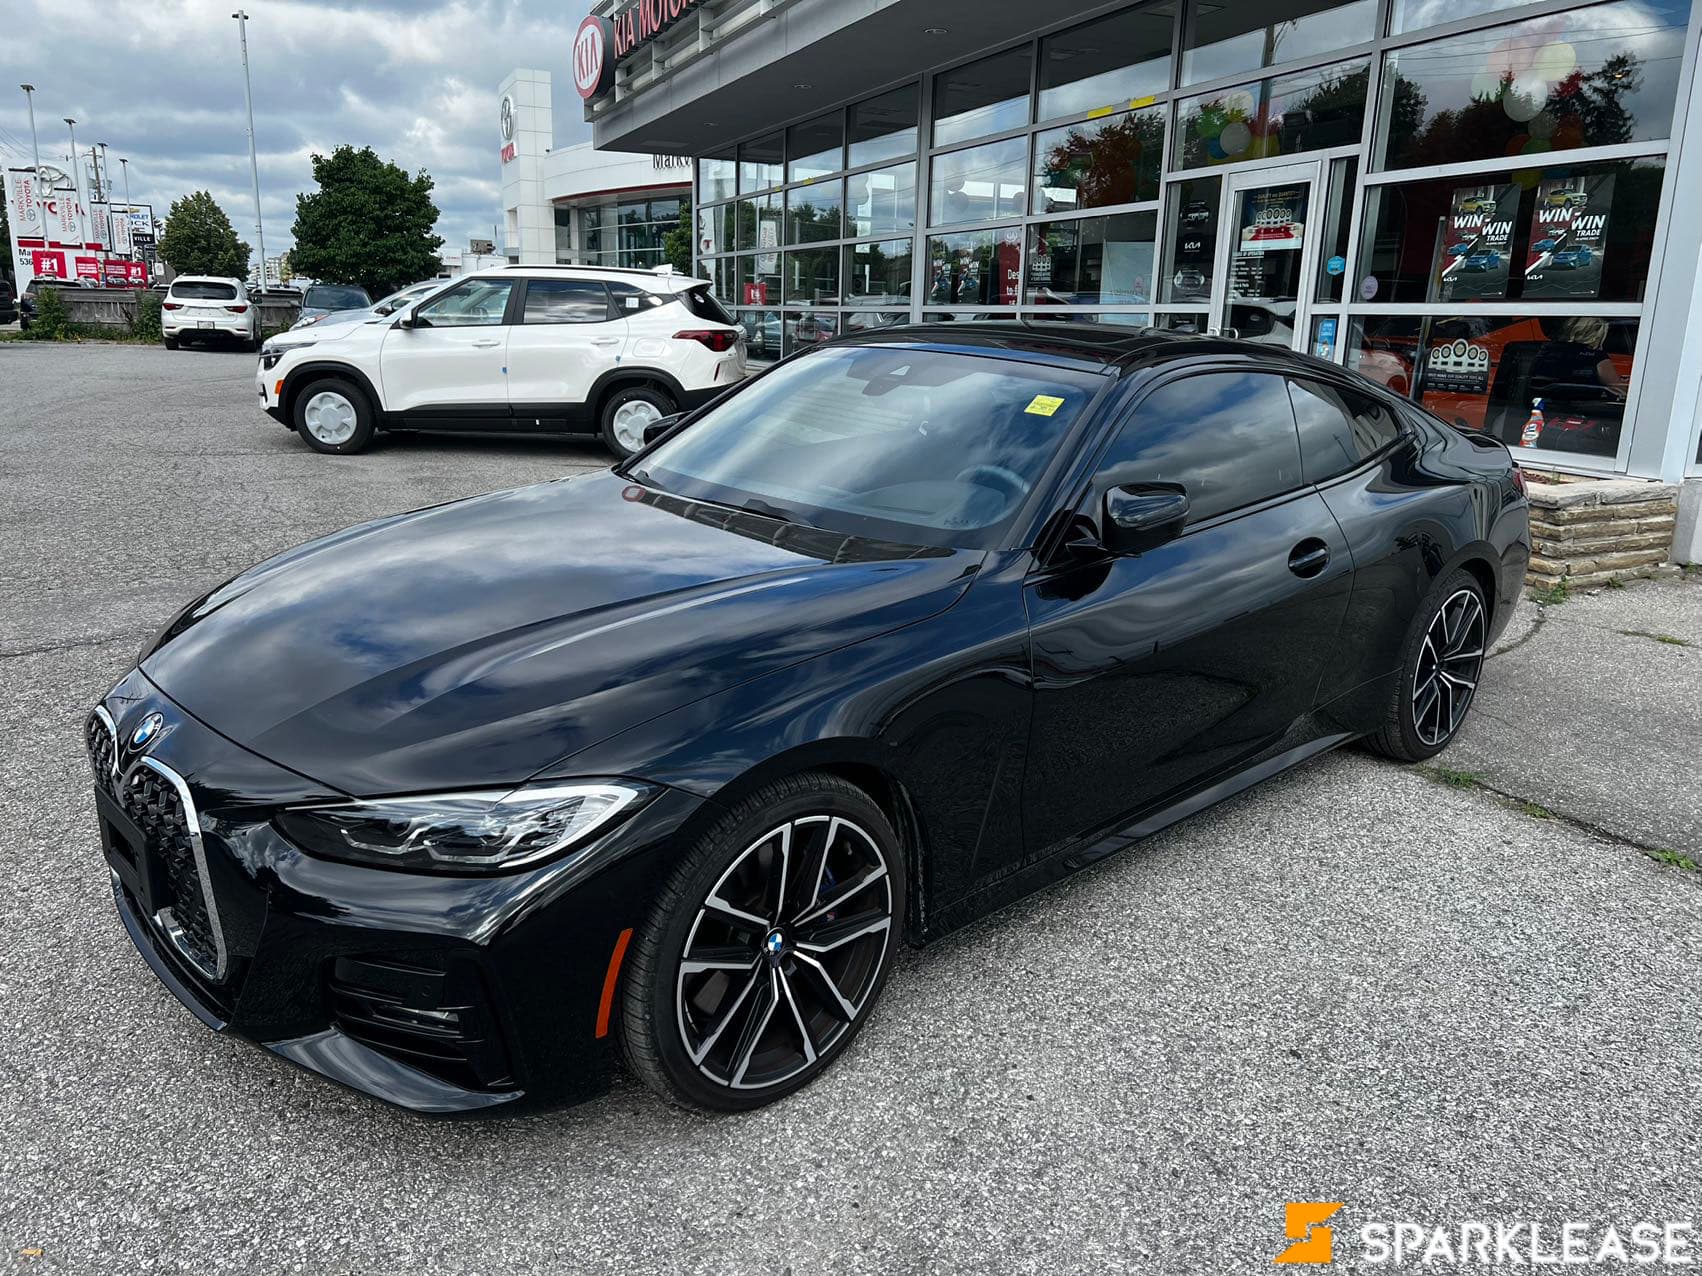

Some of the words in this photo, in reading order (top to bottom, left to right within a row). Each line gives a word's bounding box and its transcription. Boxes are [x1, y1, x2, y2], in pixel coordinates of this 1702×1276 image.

[614, 8, 635, 59] KIA
[639, 0, 694, 38] MOTO
[577, 31, 598, 82] KIA
[16, 179, 26, 221] MARKVILLE
[24, 180, 33, 208] TOYOTA
[1482, 221, 1513, 236] WIN
[1571, 215, 1606, 230] WIN
[1487, 234, 1508, 242] TRADE
[1576, 229, 1602, 237] TRADE
[40, 257, 59, 273] #1
